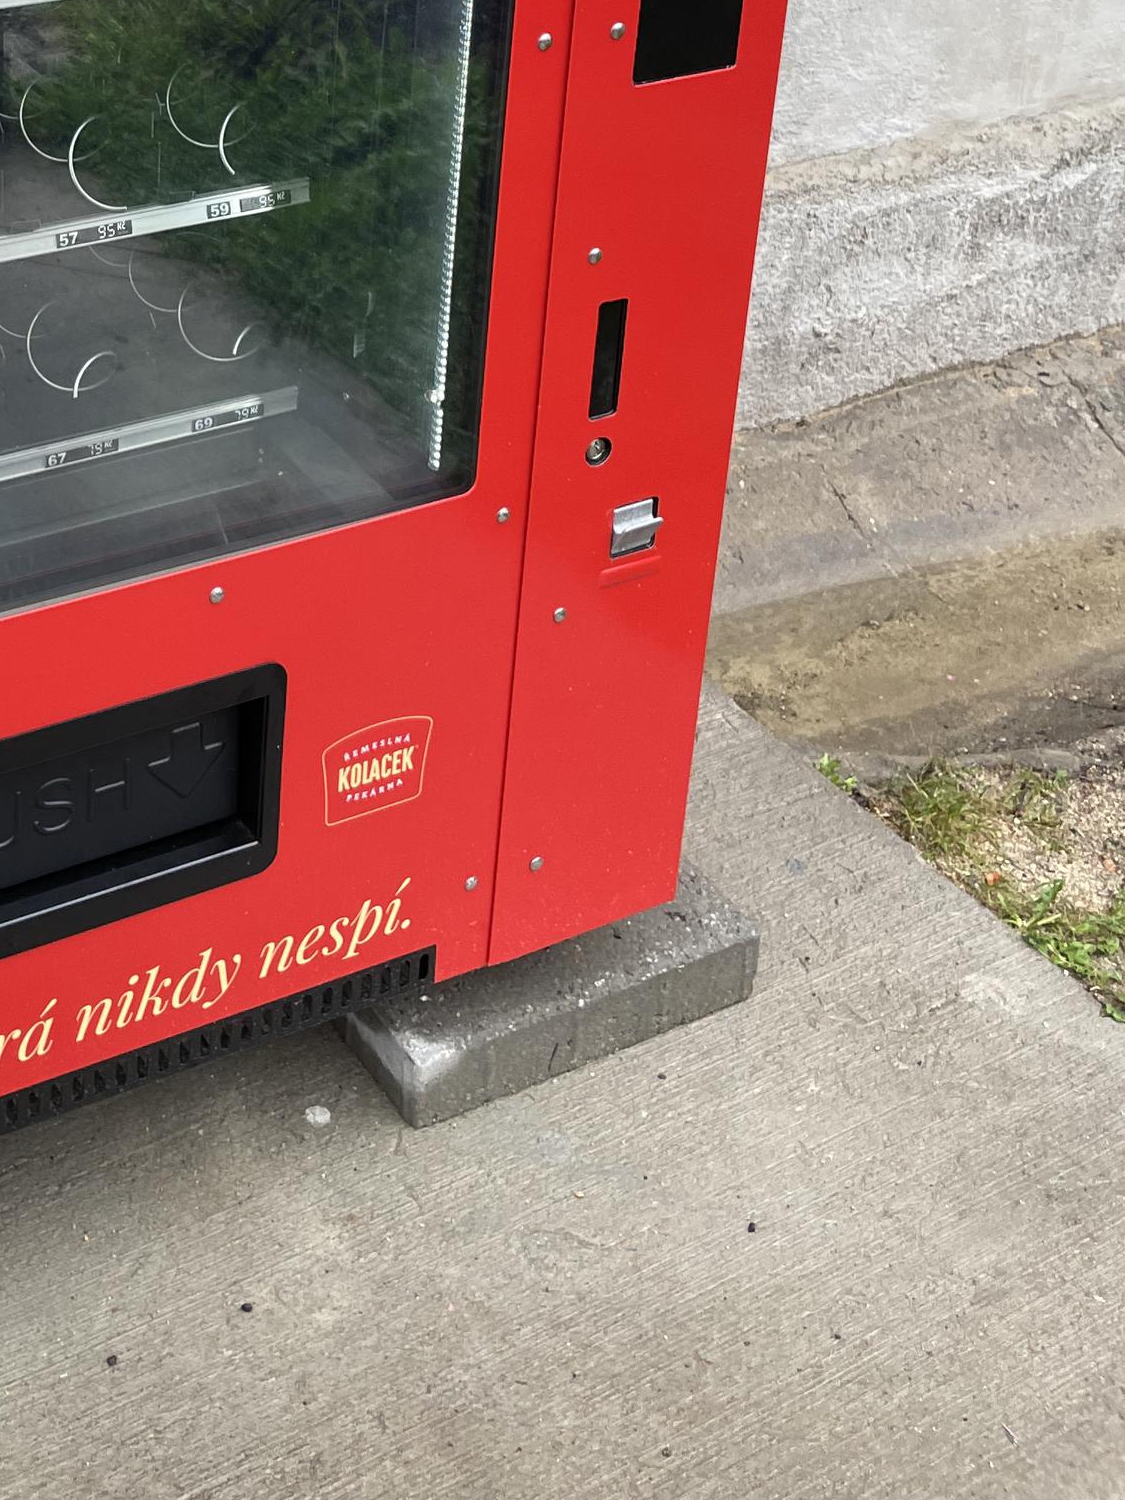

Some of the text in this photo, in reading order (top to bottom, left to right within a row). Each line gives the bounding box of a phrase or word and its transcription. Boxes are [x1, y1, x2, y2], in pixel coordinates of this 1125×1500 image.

[210, 193, 275, 218] 59 95
[59, 223, 116, 247] 57 95
[194, 417, 214, 431] 69
[47, 452, 67, 467] 67
[346, 778, 403, 803] PEKÁRNA
[76, 948, 243, 1042] nikdy
[257, 877, 413, 982] nespí.
